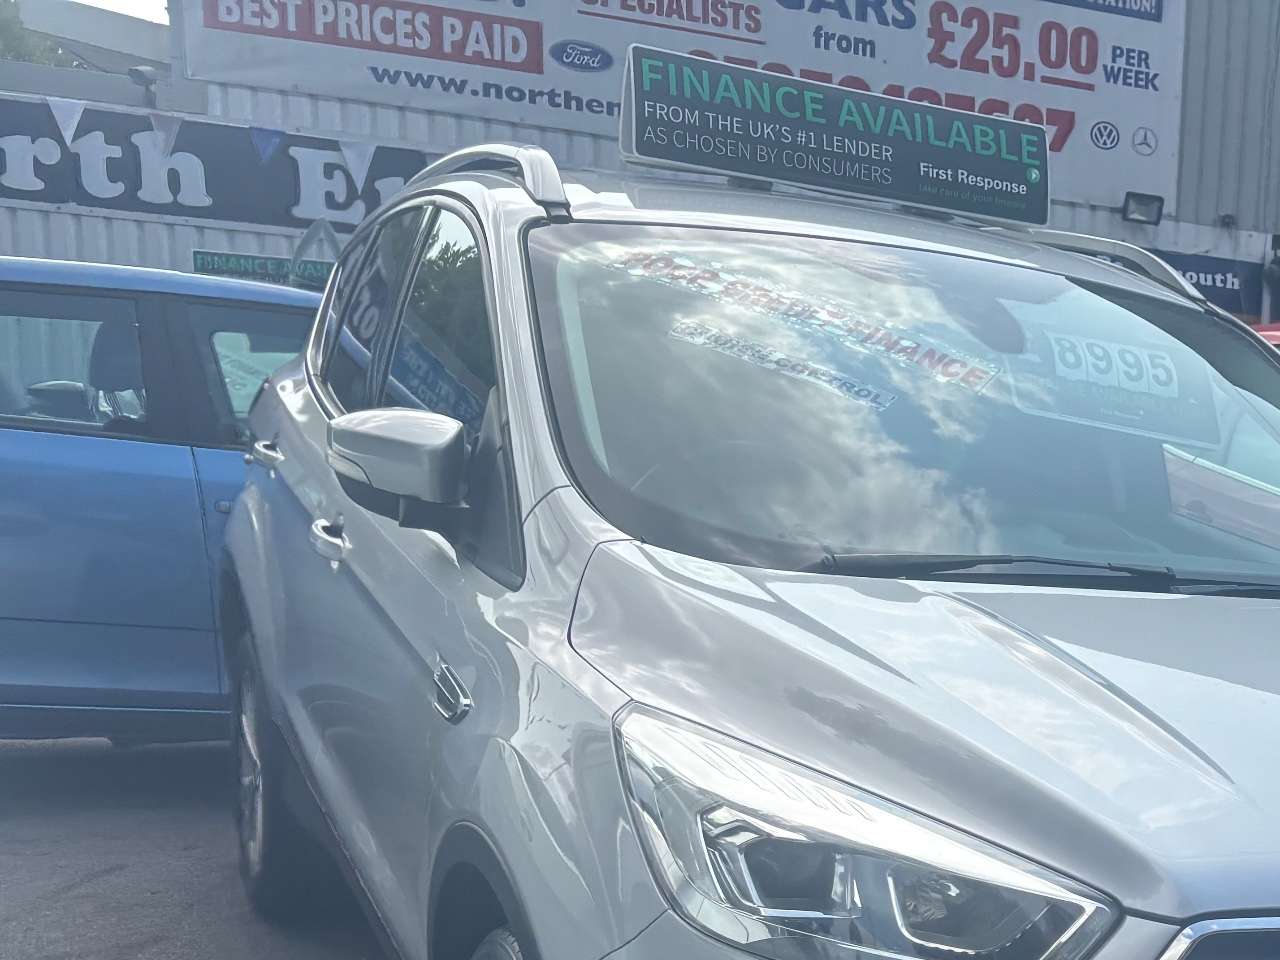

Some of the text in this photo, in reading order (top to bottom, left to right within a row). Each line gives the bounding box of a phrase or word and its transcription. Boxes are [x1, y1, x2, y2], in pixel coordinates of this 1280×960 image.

[217, 0, 528, 63] BEST PRICES PAID
[812, 25, 876, 59] from
[927, 0, 1099, 82] £25.00
[562, 44, 602, 68] Ford
[1110, 45, 1150, 69] PER
[1102, 64, 1160, 92] WEEK
[641, 57, 827, 124] FINANCE
[838, 97, 1041, 166] AVAILABLE
[644, 100, 893, 162] FROM THE UK'S #1 LENDER
[643, 125, 893, 185] AS CHOSEN BY CONSUMERS
[919, 162, 1028, 195] First Response
[196, 254, 279, 273] FINANCE
[1179, 270, 1241, 290] outh
[1054, 335, 1174, 388] 8995
